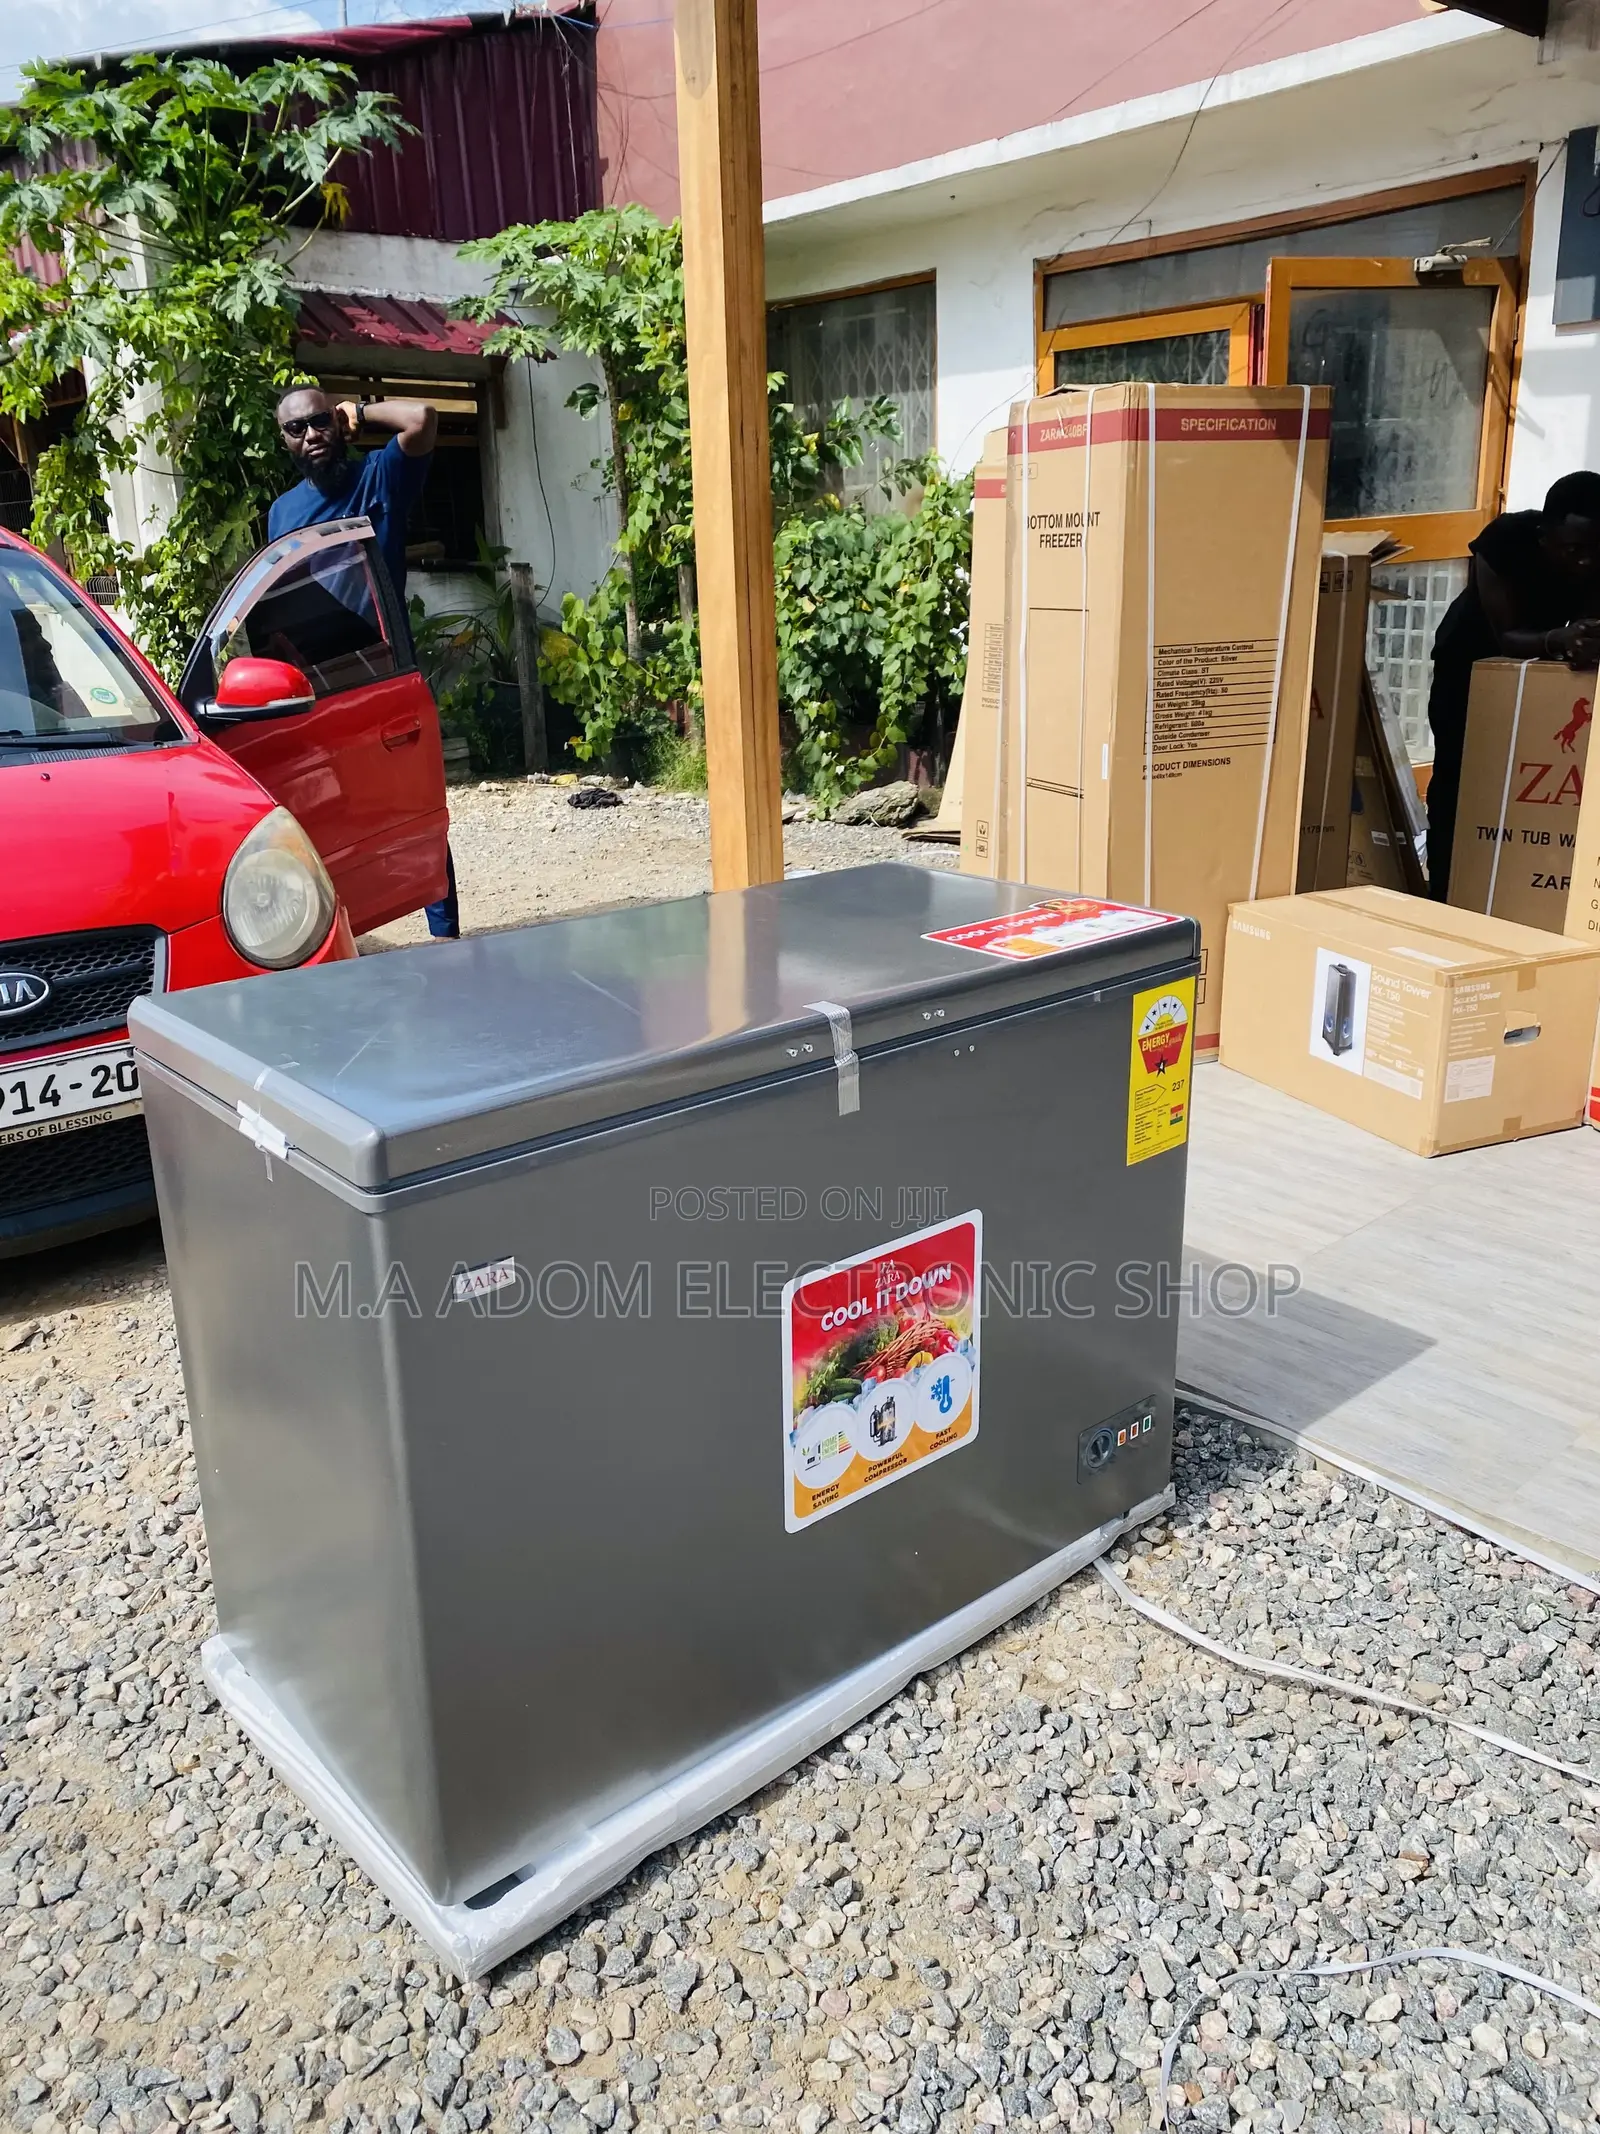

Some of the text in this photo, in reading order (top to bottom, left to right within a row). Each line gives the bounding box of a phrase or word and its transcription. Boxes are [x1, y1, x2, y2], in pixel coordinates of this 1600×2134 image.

[1180, 418, 1277, 432] SPECIFICATION
[1039, 533, 1083, 548] FREEZER
[1158, 647, 1192, 655] Mechanical
[1194, 645, 1230, 653] Temperature
[1142, 757, 1231, 773] PODUCT DIMENSIONS
[1476, 826, 1513, 842] TWN
[1521, 829, 1551, 846] TUB
[946, 929, 995, 942] COOL
[1006, 912, 1060, 927] DOWN
[1232, 919, 1272, 941] SAMSUNG
[1371, 971, 1432, 999] Sound Tower
[1454, 982, 1491, 995] SAMSUNG
[1454, 991, 1502, 1005] Sound Tower
[1142, 1032, 1170, 1052] ENERGY
[0, 1060, 139, 1115] 14-20
[1172, 1079, 1185, 1092] 237
[27, 1125, 46, 1138] OF
[49, 1111, 114, 1134] BLESSING
[460, 1266, 509, 1296] ZARA
[874, 1271, 901, 1289] ZARA
[820, 1263, 952, 1332] COOL IT DOWN
[929, 1432, 958, 1450] COOLING
[935, 1426, 952, 1439] FAST
[863, 1457, 908, 1483] COMPRESSOR
[867, 1452, 904, 1473] POWERFUL
[811, 1483, 840, 1501] ENERGY
[812, 1492, 839, 1510] SAVING
